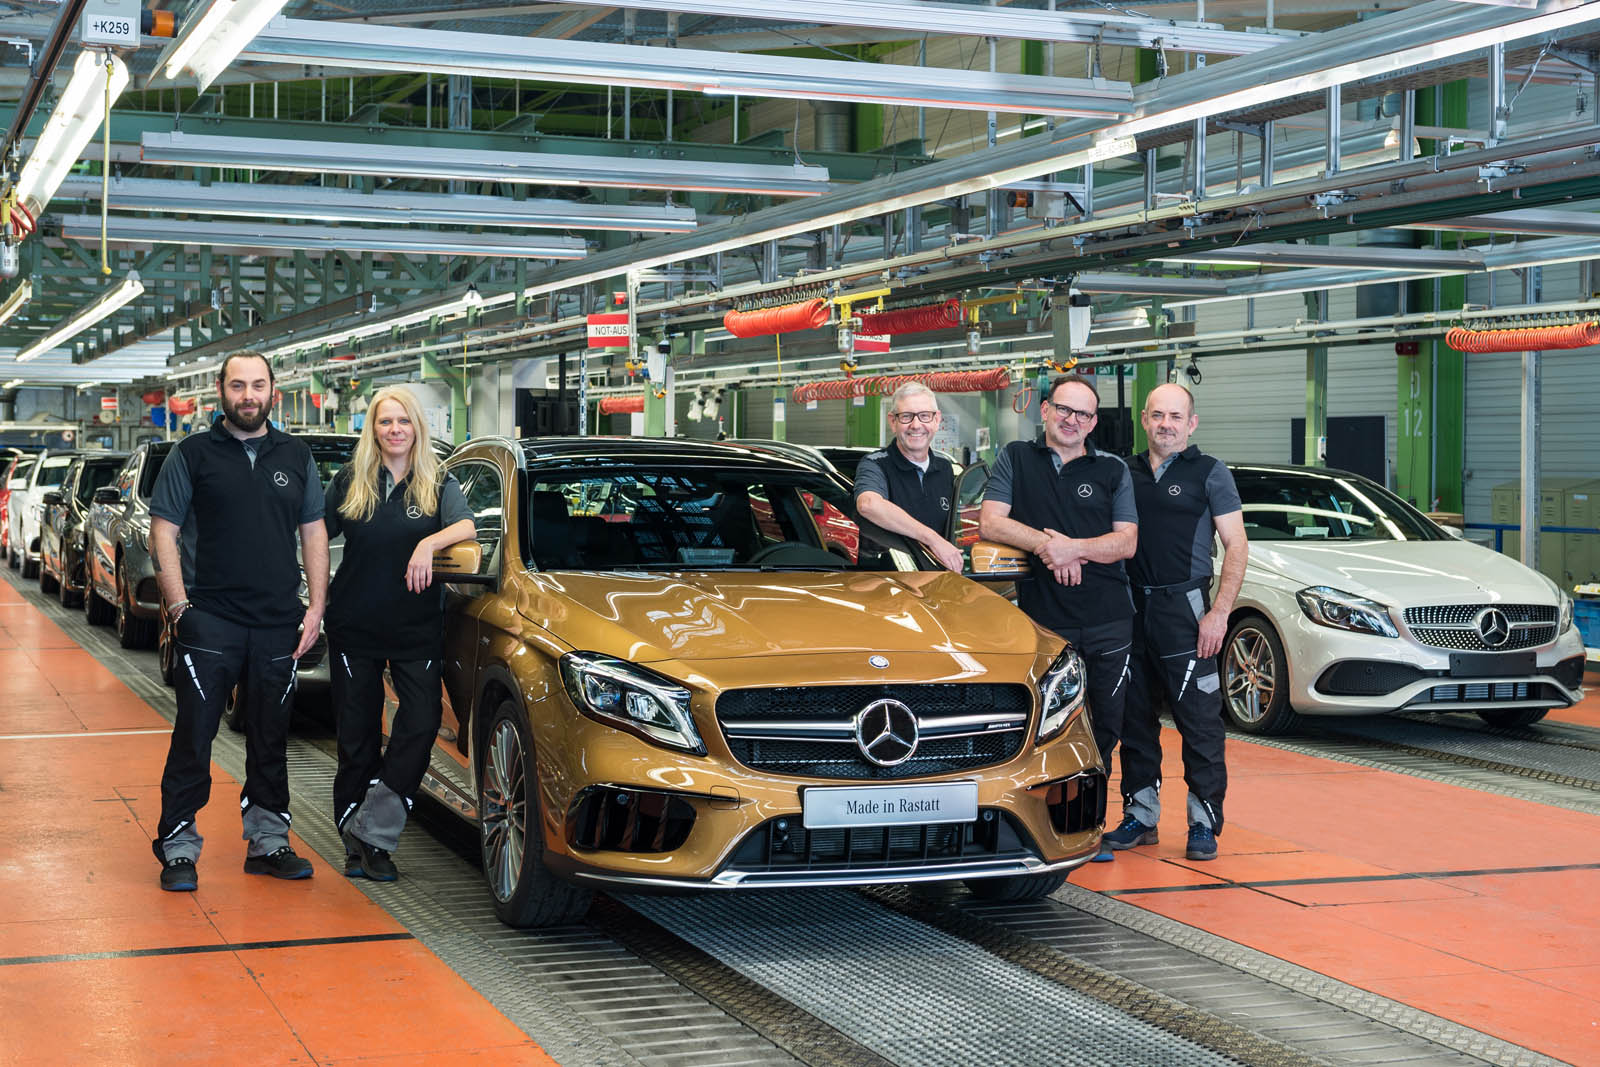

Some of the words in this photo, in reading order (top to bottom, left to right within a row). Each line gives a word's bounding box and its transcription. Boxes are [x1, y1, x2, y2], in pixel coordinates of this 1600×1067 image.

[93, 20, 130, 35] +K259
[595, 325, 628, 336] NOT-AUS
[1410, 371, 1421, 399] D
[1404, 408, 1423, 437] 12
[846, 800, 880, 815] Made
[883, 799, 895, 813] in
[899, 798, 940, 813] Rastatt
